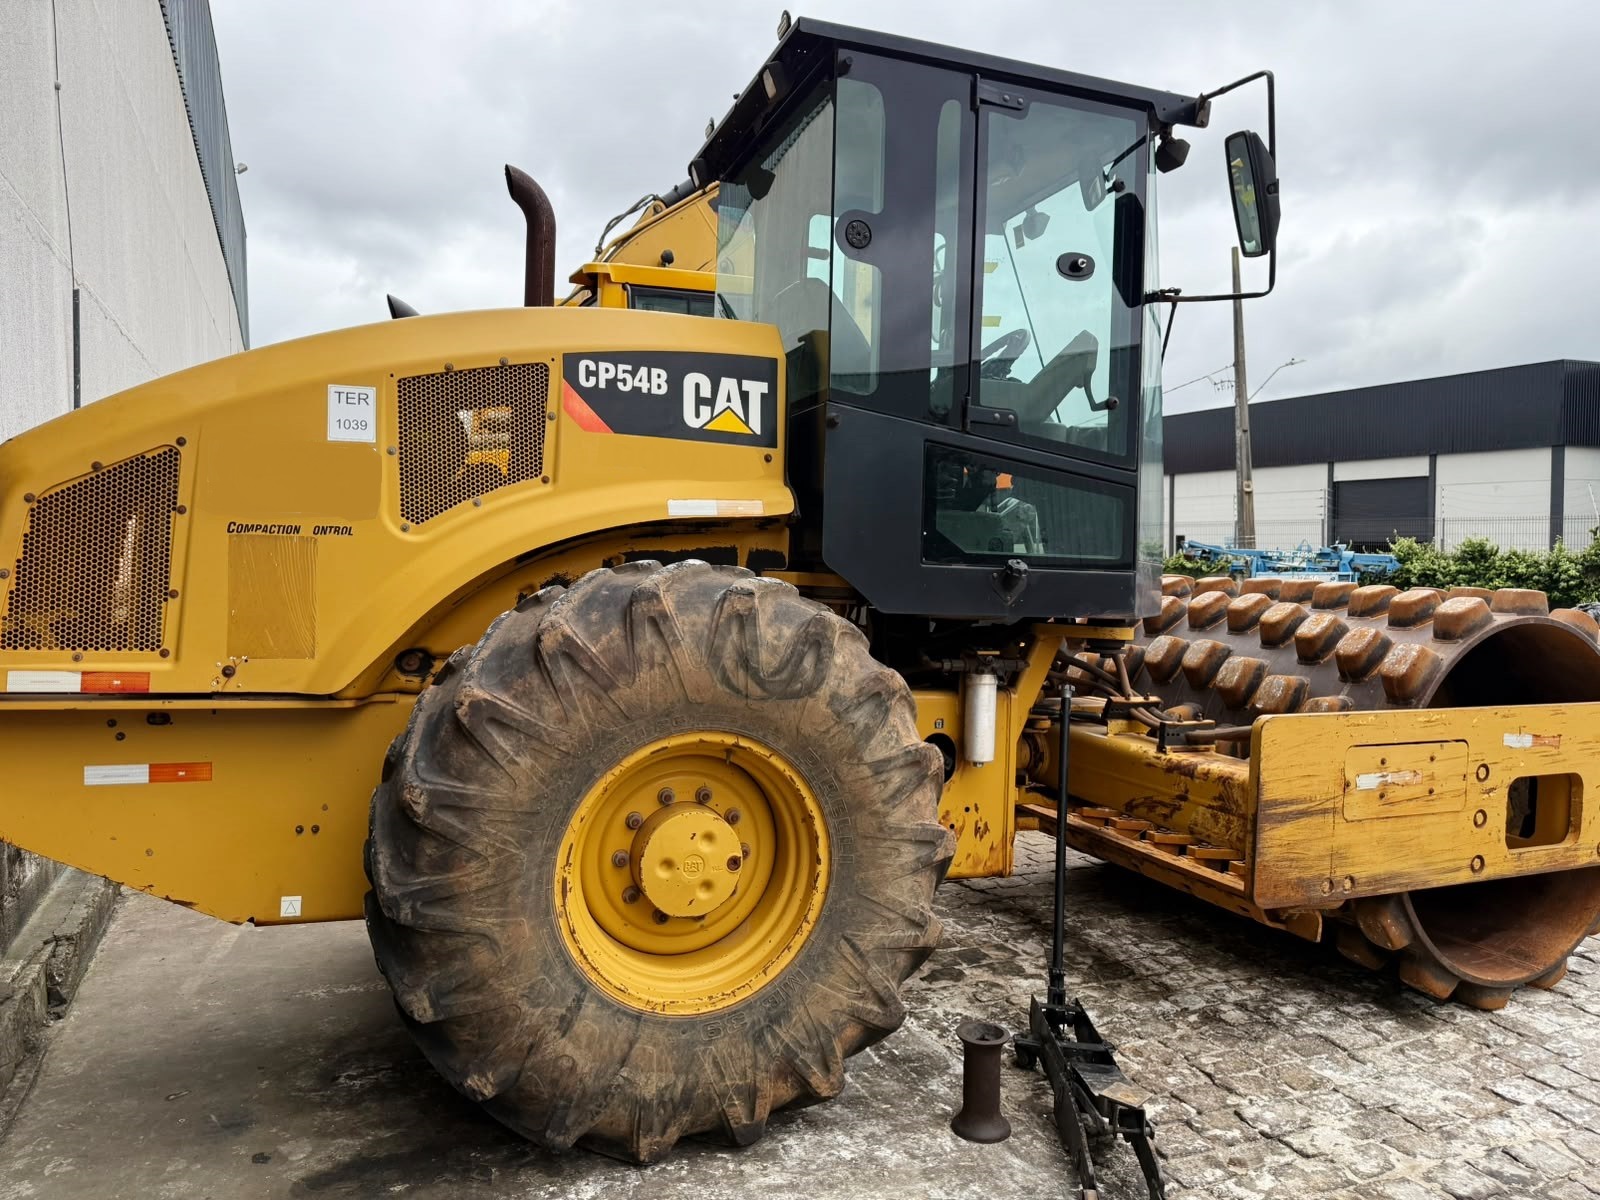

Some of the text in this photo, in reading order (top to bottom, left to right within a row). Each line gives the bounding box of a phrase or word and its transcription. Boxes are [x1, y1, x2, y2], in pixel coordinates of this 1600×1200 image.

[578, 359, 668, 396] CP54B
[334, 391, 369, 406] TER
[682, 372, 769, 436] CAT
[336, 418, 367, 431] 1039
[227, 521, 301, 535] COMPACTION
